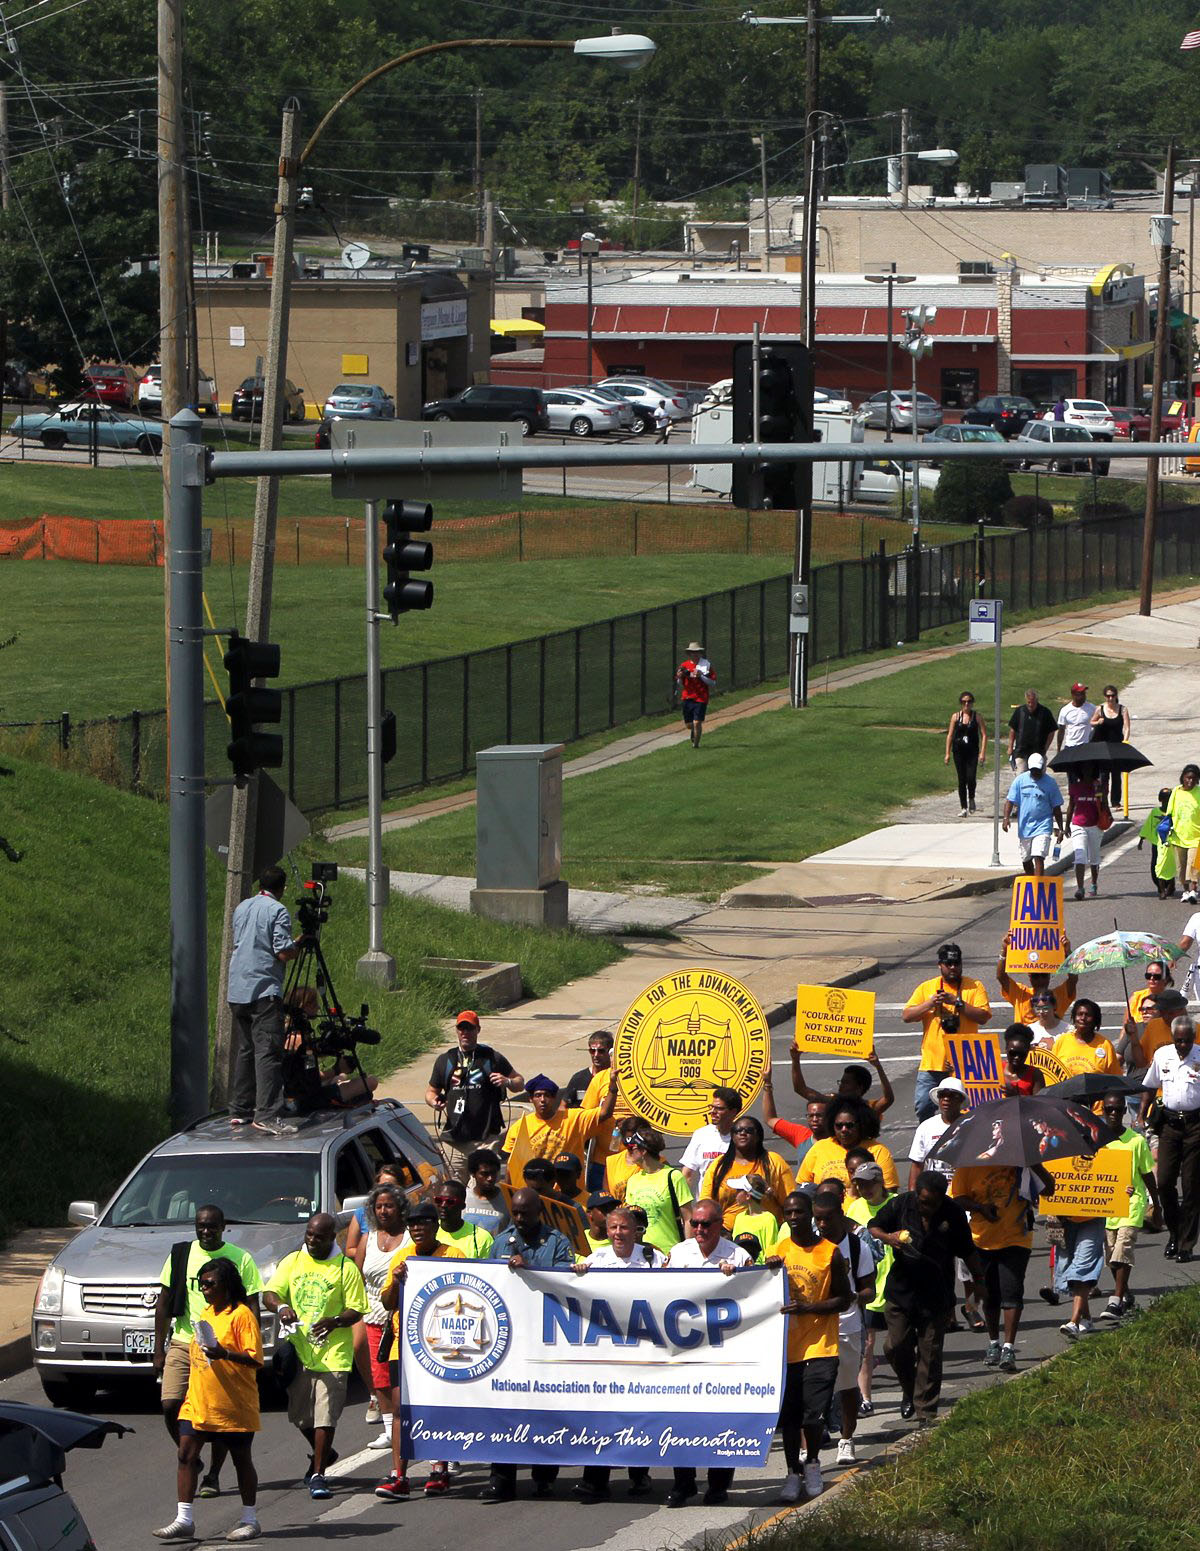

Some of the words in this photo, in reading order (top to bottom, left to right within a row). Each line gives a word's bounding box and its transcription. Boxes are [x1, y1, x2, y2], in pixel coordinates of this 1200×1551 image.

[1014, 883, 1020, 920] I
[1021, 882, 1058, 920] AM
[1010, 928, 1059, 950] HUMAN
[672, 974, 691, 991] THE
[647, 985, 667, 1005] FOR
[698, 974, 759, 1024] ADVANCEMENT
[848, 1015, 866, 1024] WILL
[749, 1029, 764, 1042] OF
[824, 1025, 842, 1033] SKIP
[845, 1028, 863, 1036] THIS
[619, 1010, 644, 1080] ASSOCIATION
[667, 1039, 716, 1056] NAACP
[949, 1040, 961, 1080] I
[962, 1040, 998, 1080] AM
[680, 1066, 701, 1078] 1909
[739, 1052, 764, 1099] COLORED
[628, 1088, 671, 1126] NATIONAL
[1096, 1174, 1119, 1182] WILL
[1093, 1186, 1114, 1194] THIS
[424, 1280, 439, 1295] FOR
[442, 1274, 456, 1285] THE
[459, 1274, 502, 1309] ADVANCEMENT
[408, 1295, 425, 1345] ASSOCIATION
[442, 1318, 474, 1330] NAACP
[498, 1313, 508, 1322] OF
[542, 1293, 743, 1350] NAACP
[126, 1335, 144, 1348] CK2
[450, 1336, 465, 1344] 1909
[492, 1327, 509, 1359] COLORED
[414, 1349, 445, 1377] NATIONAL
[467, 1359, 493, 1378] PEOPLE
[491, 1379, 531, 1392] National
[533, 1380, 590, 1394] Association
[592, 1380, 607, 1394] for
[609, 1381, 625, 1394] the
[628, 1382, 690, 1395] Advancement
[692, 1382, 703, 1395] of
[705, 1382, 741, 1395] Colored
[744, 1383, 775, 1398] People
[490, 1423, 531, 1444] will
[533, 1426, 569, 1446] not
[570, 1430, 613, 1455] skip
[613, 1426, 653, 1447] this
